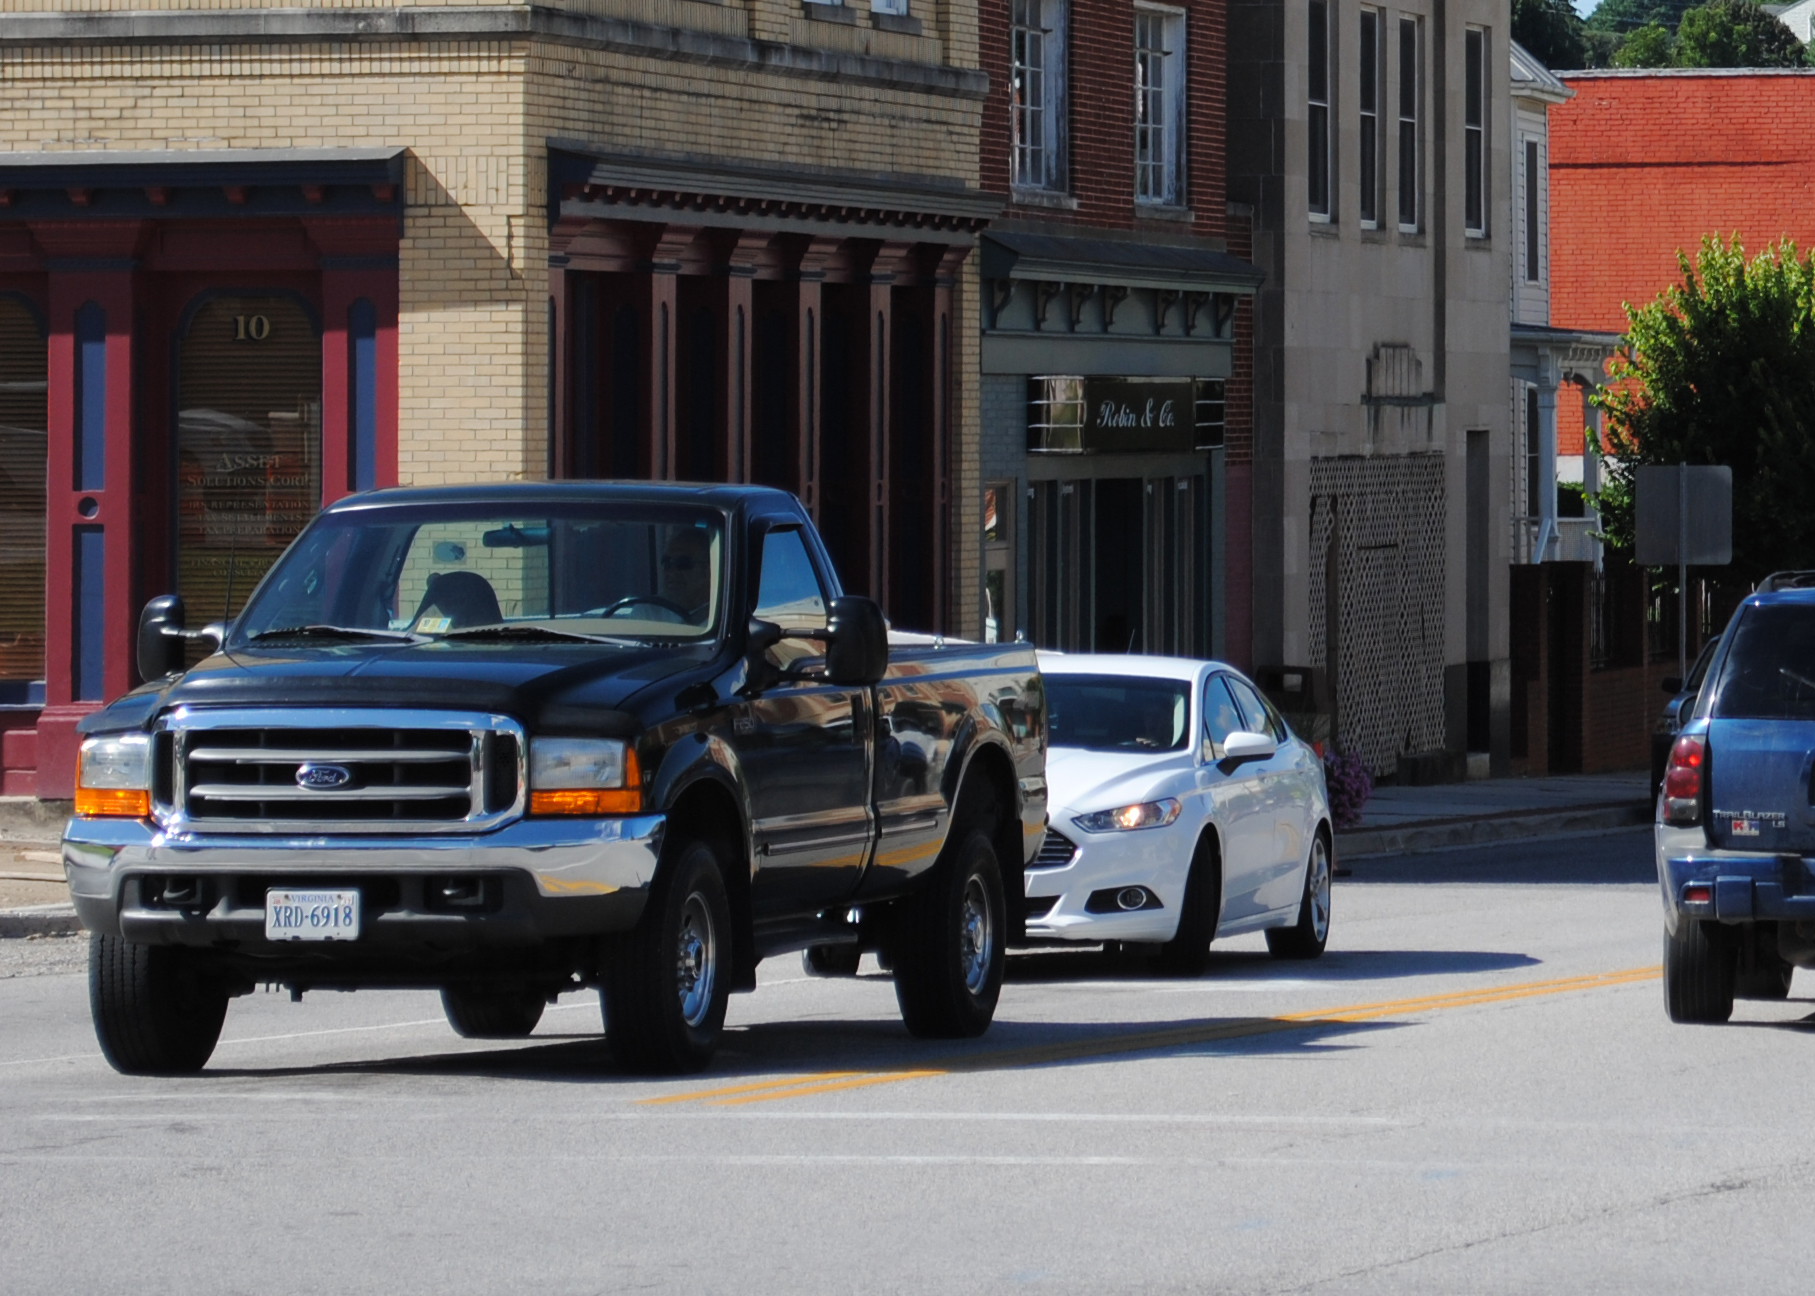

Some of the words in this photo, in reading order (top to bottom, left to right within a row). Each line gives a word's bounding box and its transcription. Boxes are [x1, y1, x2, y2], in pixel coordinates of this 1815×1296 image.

[234, 314, 270, 341] 10
[1096, 399, 1137, 428] Robin
[1140, 397, 1157, 428] &
[1158, 399, 1175, 428] Co.
[215, 452, 283, 470] ASSET
[186, 474, 265, 487] SOLUTIONS
[308, 769, 338, 783] Ford
[291, 894, 334, 903] VIRGINIA
[271, 904, 353, 928] XRD-6918
